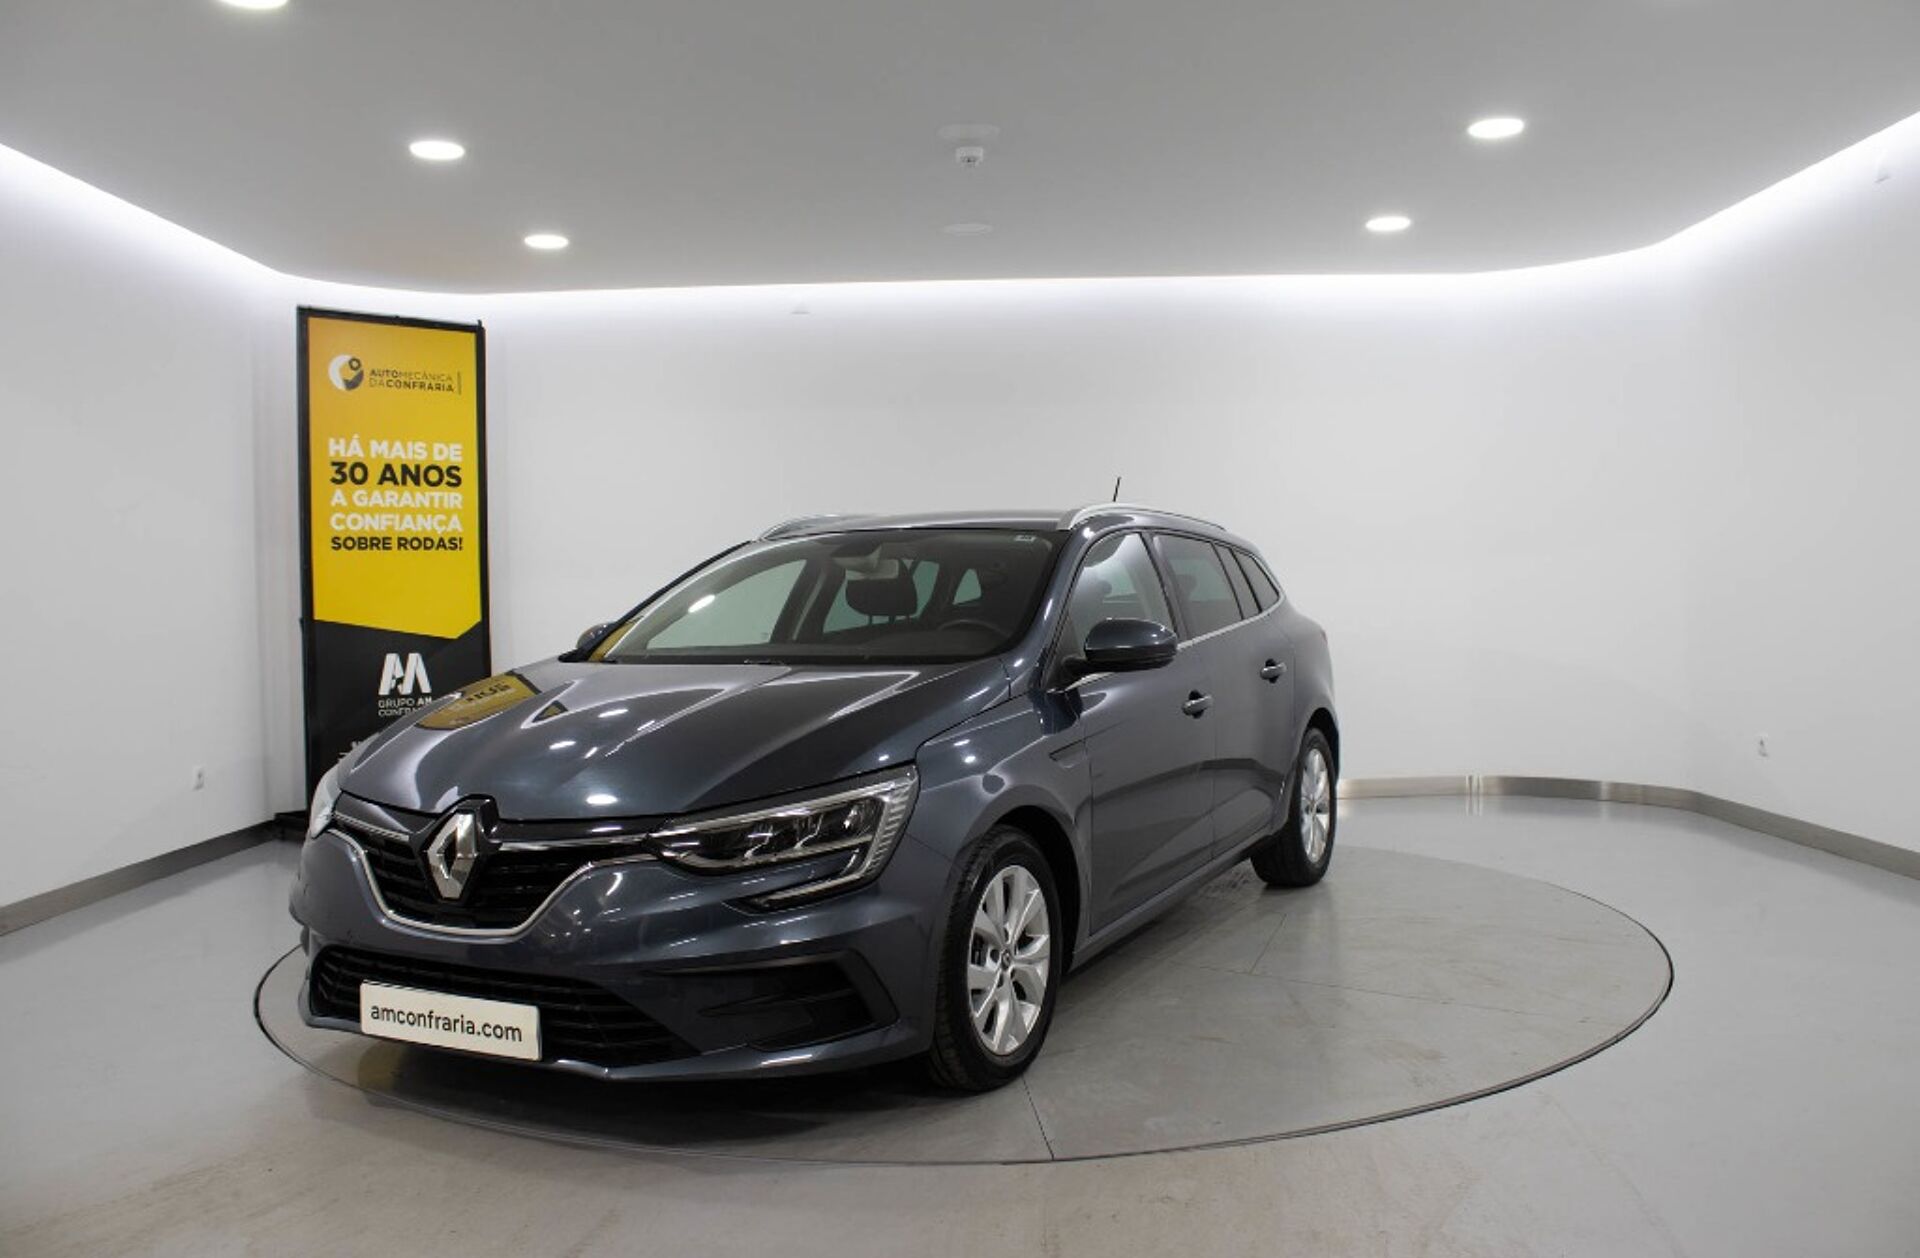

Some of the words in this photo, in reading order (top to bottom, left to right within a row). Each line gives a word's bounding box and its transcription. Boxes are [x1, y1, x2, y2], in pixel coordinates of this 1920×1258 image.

[328, 434, 364, 457] HÁ
[369, 439, 428, 460] MAIS
[432, 443, 463, 462] DE
[330, 461, 369, 485] 30
[377, 463, 462, 488] ANOS
[330, 489, 348, 507] A
[352, 490, 463, 509] GARANTIR
[330, 512, 463, 534] CONFIANÇA
[331, 536, 393, 550] SOBRE
[397, 537, 463, 551] RODAS!
[378, 698, 415, 708] GRUPO
[370, 1004, 523, 1043] amconfraria.com
